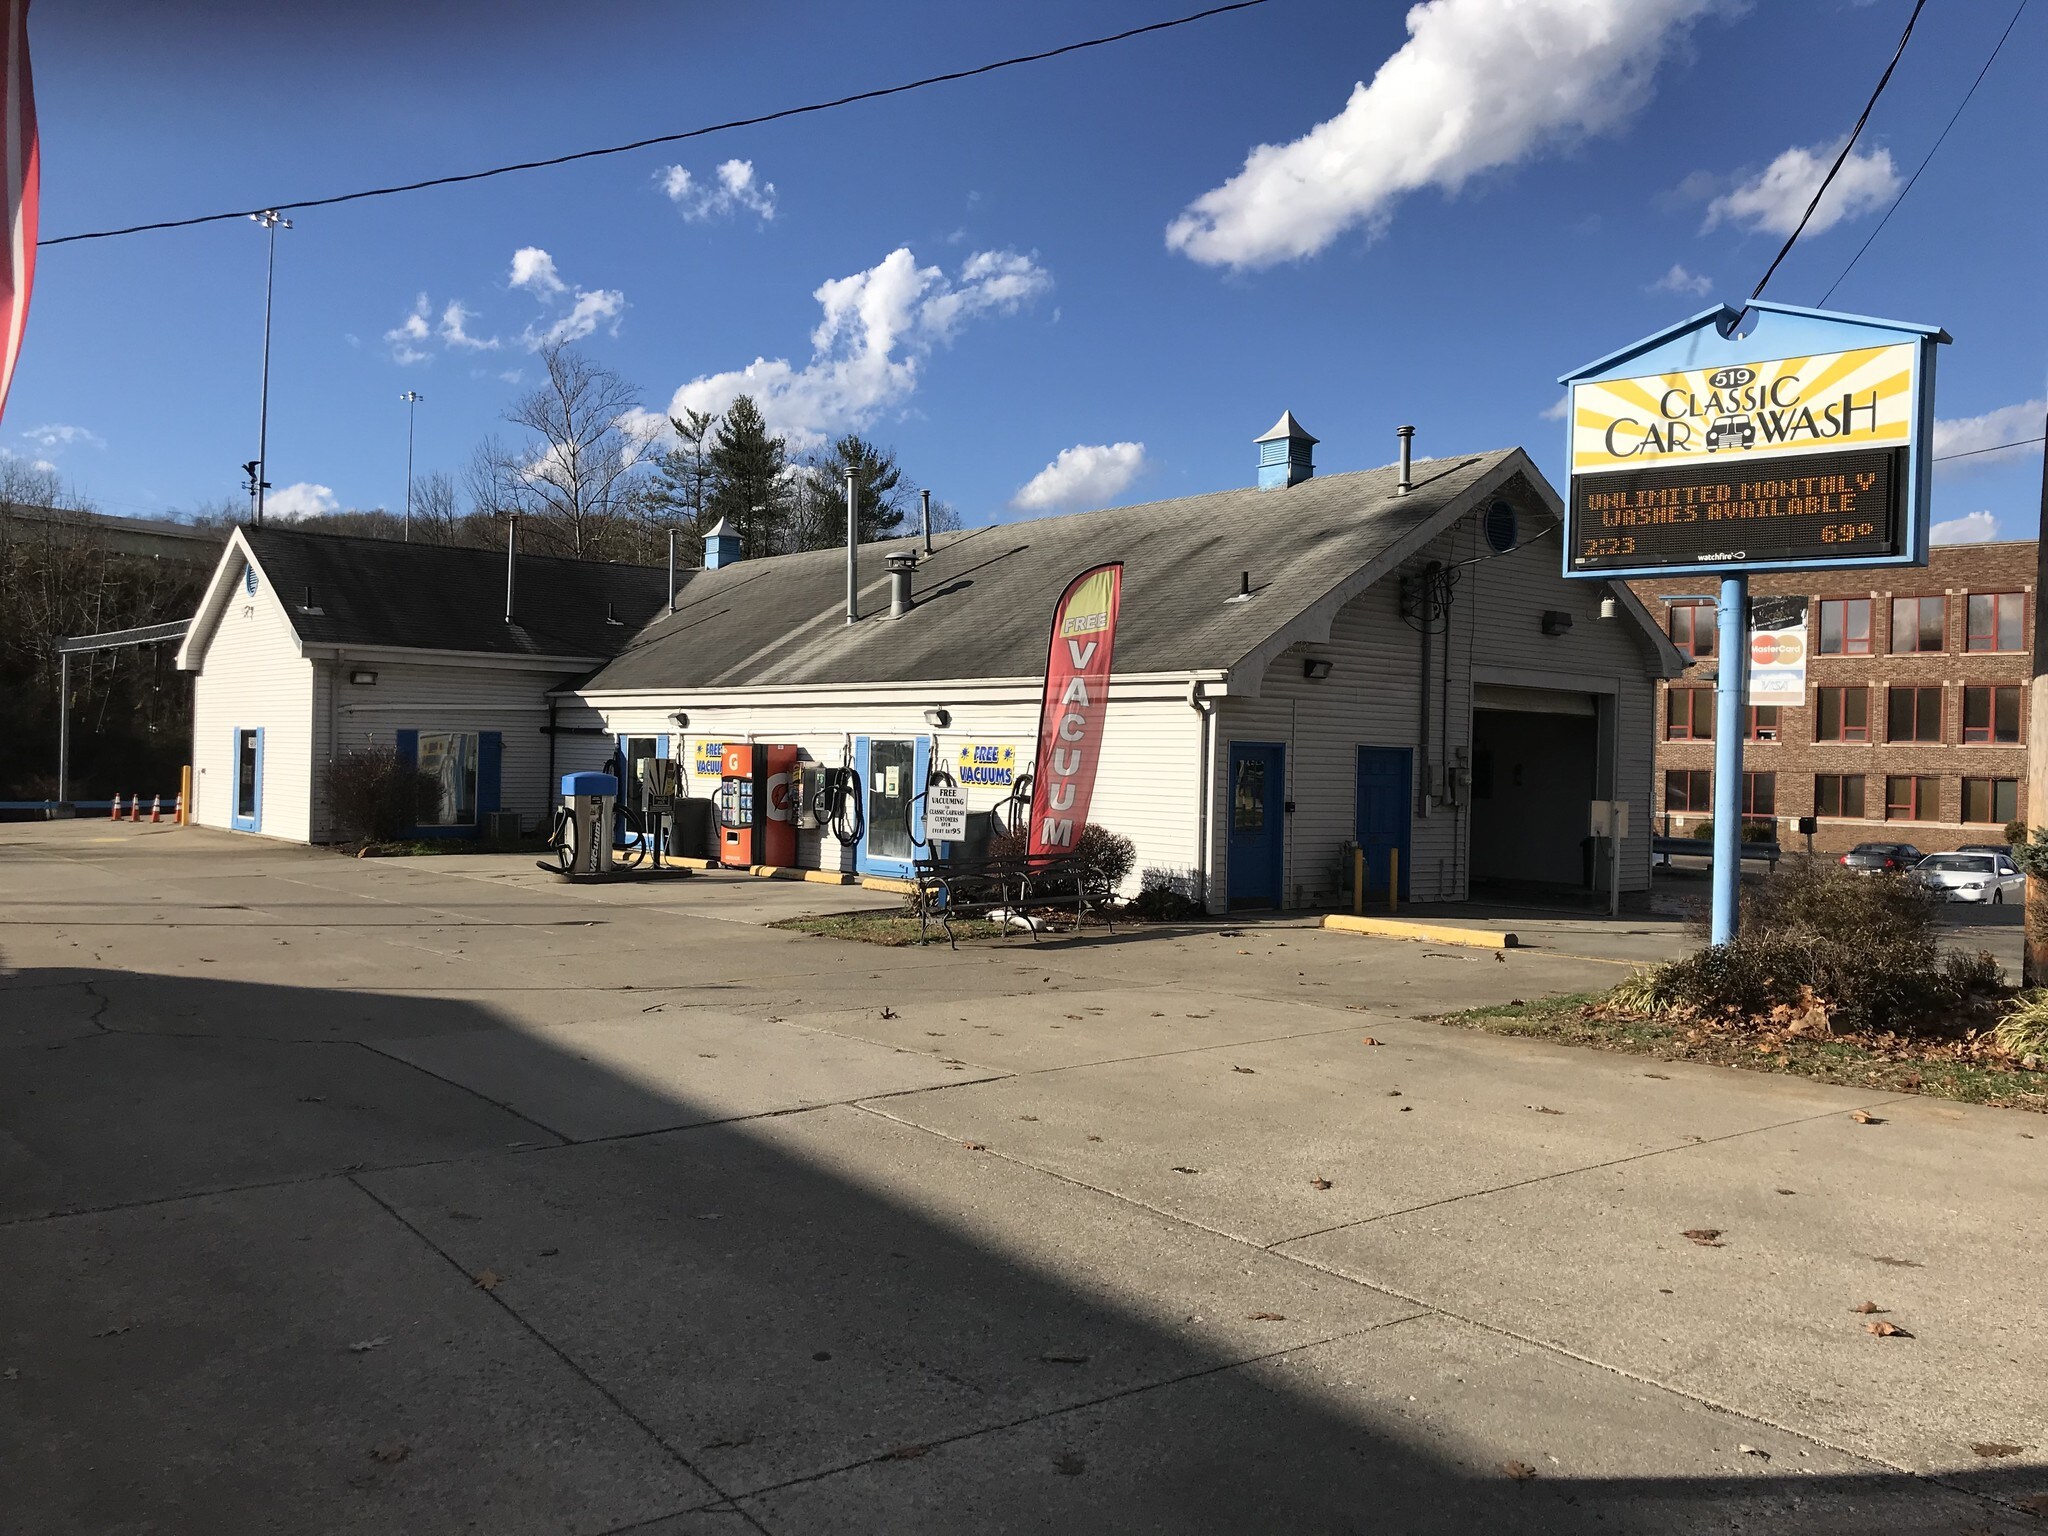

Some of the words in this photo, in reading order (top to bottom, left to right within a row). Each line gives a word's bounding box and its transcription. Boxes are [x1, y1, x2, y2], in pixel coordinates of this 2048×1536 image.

[1714, 369, 1751, 387] 519
[1660, 375, 1800, 420] CLASSIC
[1604, 417, 1691, 458] CAR
[1755, 389, 1877, 444] WASH
[1587, 483, 1732, 511] UNLIMITED
[1740, 471, 1876, 500] MONTHLY
[1602, 503, 1699, 527] WASHES
[1707, 493, 1857, 521] AVAILABLE
[1584, 537, 1636, 556] 2:23
[1697, 552, 1733, 562] watchfire
[1064, 612, 1107, 633] FREE
[1751, 645, 1801, 654] MasterCard
[973, 745, 999, 762] FREE
[1040, 639, 1098, 848] VACUUM
[959, 765, 1012, 786] VACUUMS
[932, 797, 964, 805] VACUUMING
[940, 789, 957, 797] FREE
